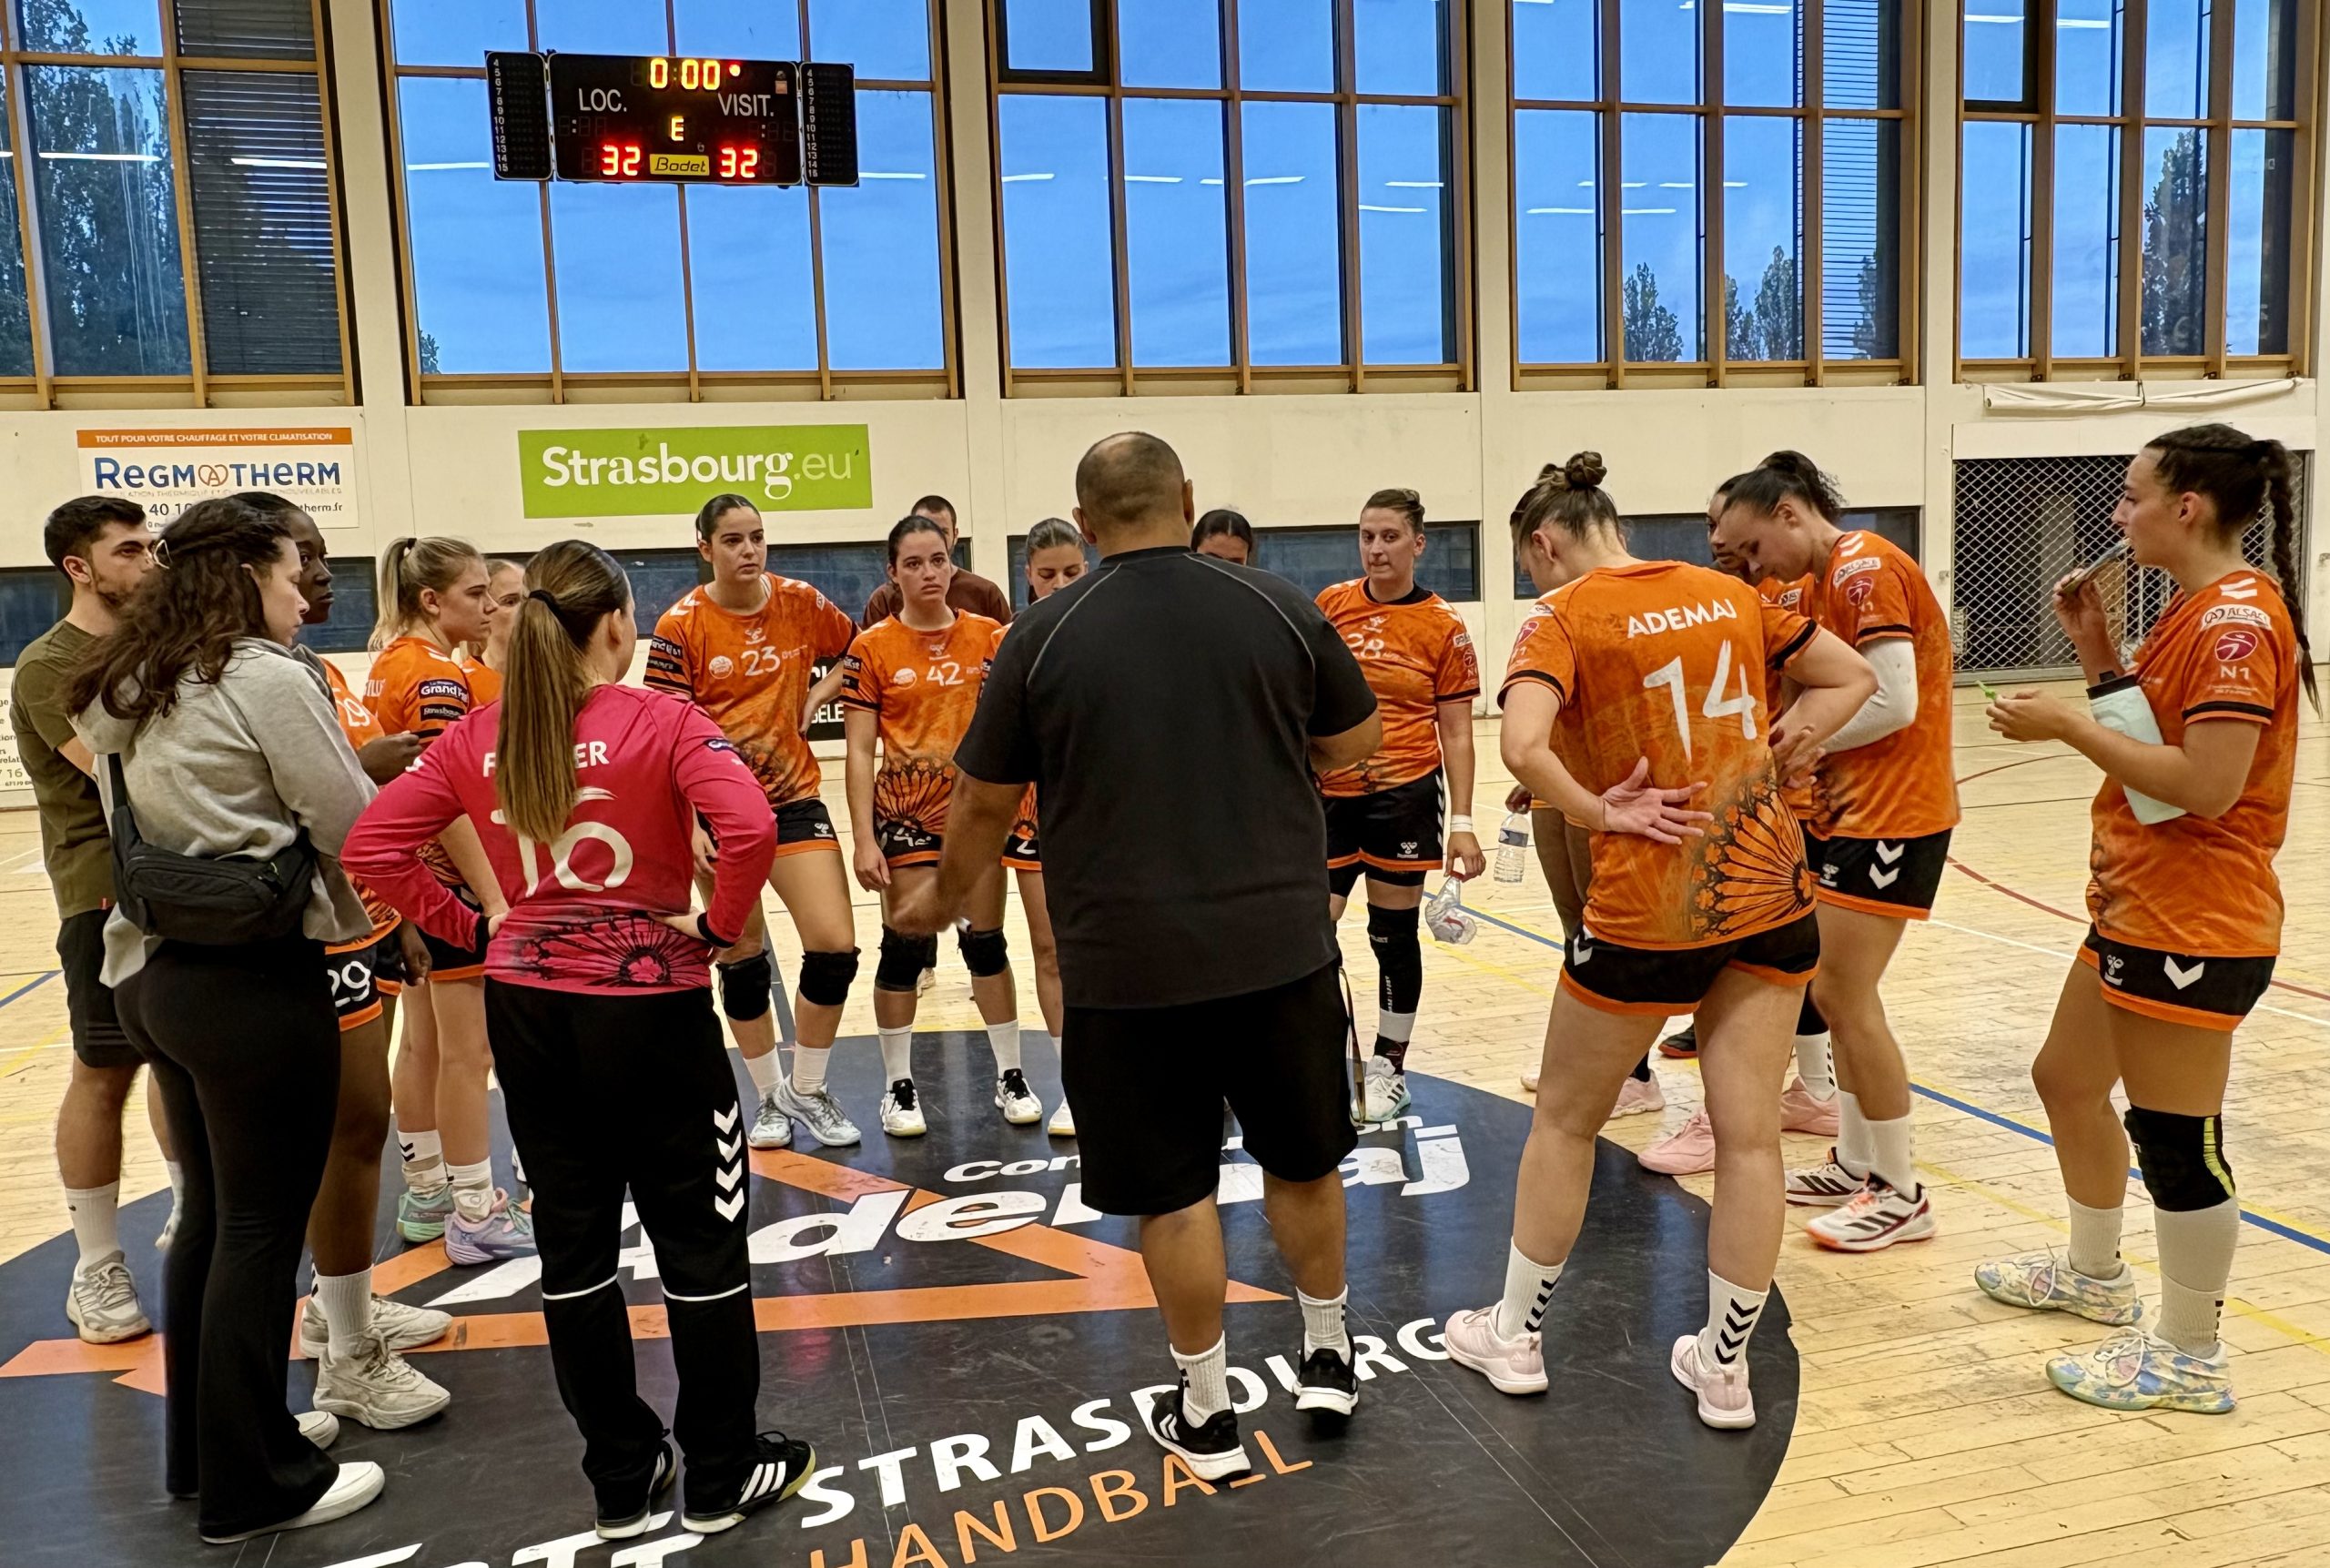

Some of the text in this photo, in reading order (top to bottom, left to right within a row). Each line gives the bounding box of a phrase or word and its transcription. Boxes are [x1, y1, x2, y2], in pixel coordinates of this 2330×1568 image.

[578, 88, 627, 113] LOC.
[718, 94, 775, 117] VISIT.
[494, 116, 504, 125] 10
[671, 118, 684, 141] E
[495, 136, 506, 144] 12
[496, 145, 507, 153] 13
[497, 154, 507, 162] 14
[498, 164, 508, 172] 15
[602, 145, 641, 177] 32
[654, 157, 706, 173] Bodet
[720, 147, 757, 178] 32
[121, 435, 147, 443] POUR
[147, 435, 175, 443] VOTRE
[542, 443, 851, 500] Strasbourg.eu
[149, 503, 169, 515] 40
[1626, 598, 1737, 639] ADEMAJ
[741, 645, 781, 676] 23
[927, 662, 965, 687] 42
[2220, 665, 2250, 680] N1
[1643, 640, 1756, 763] 14
